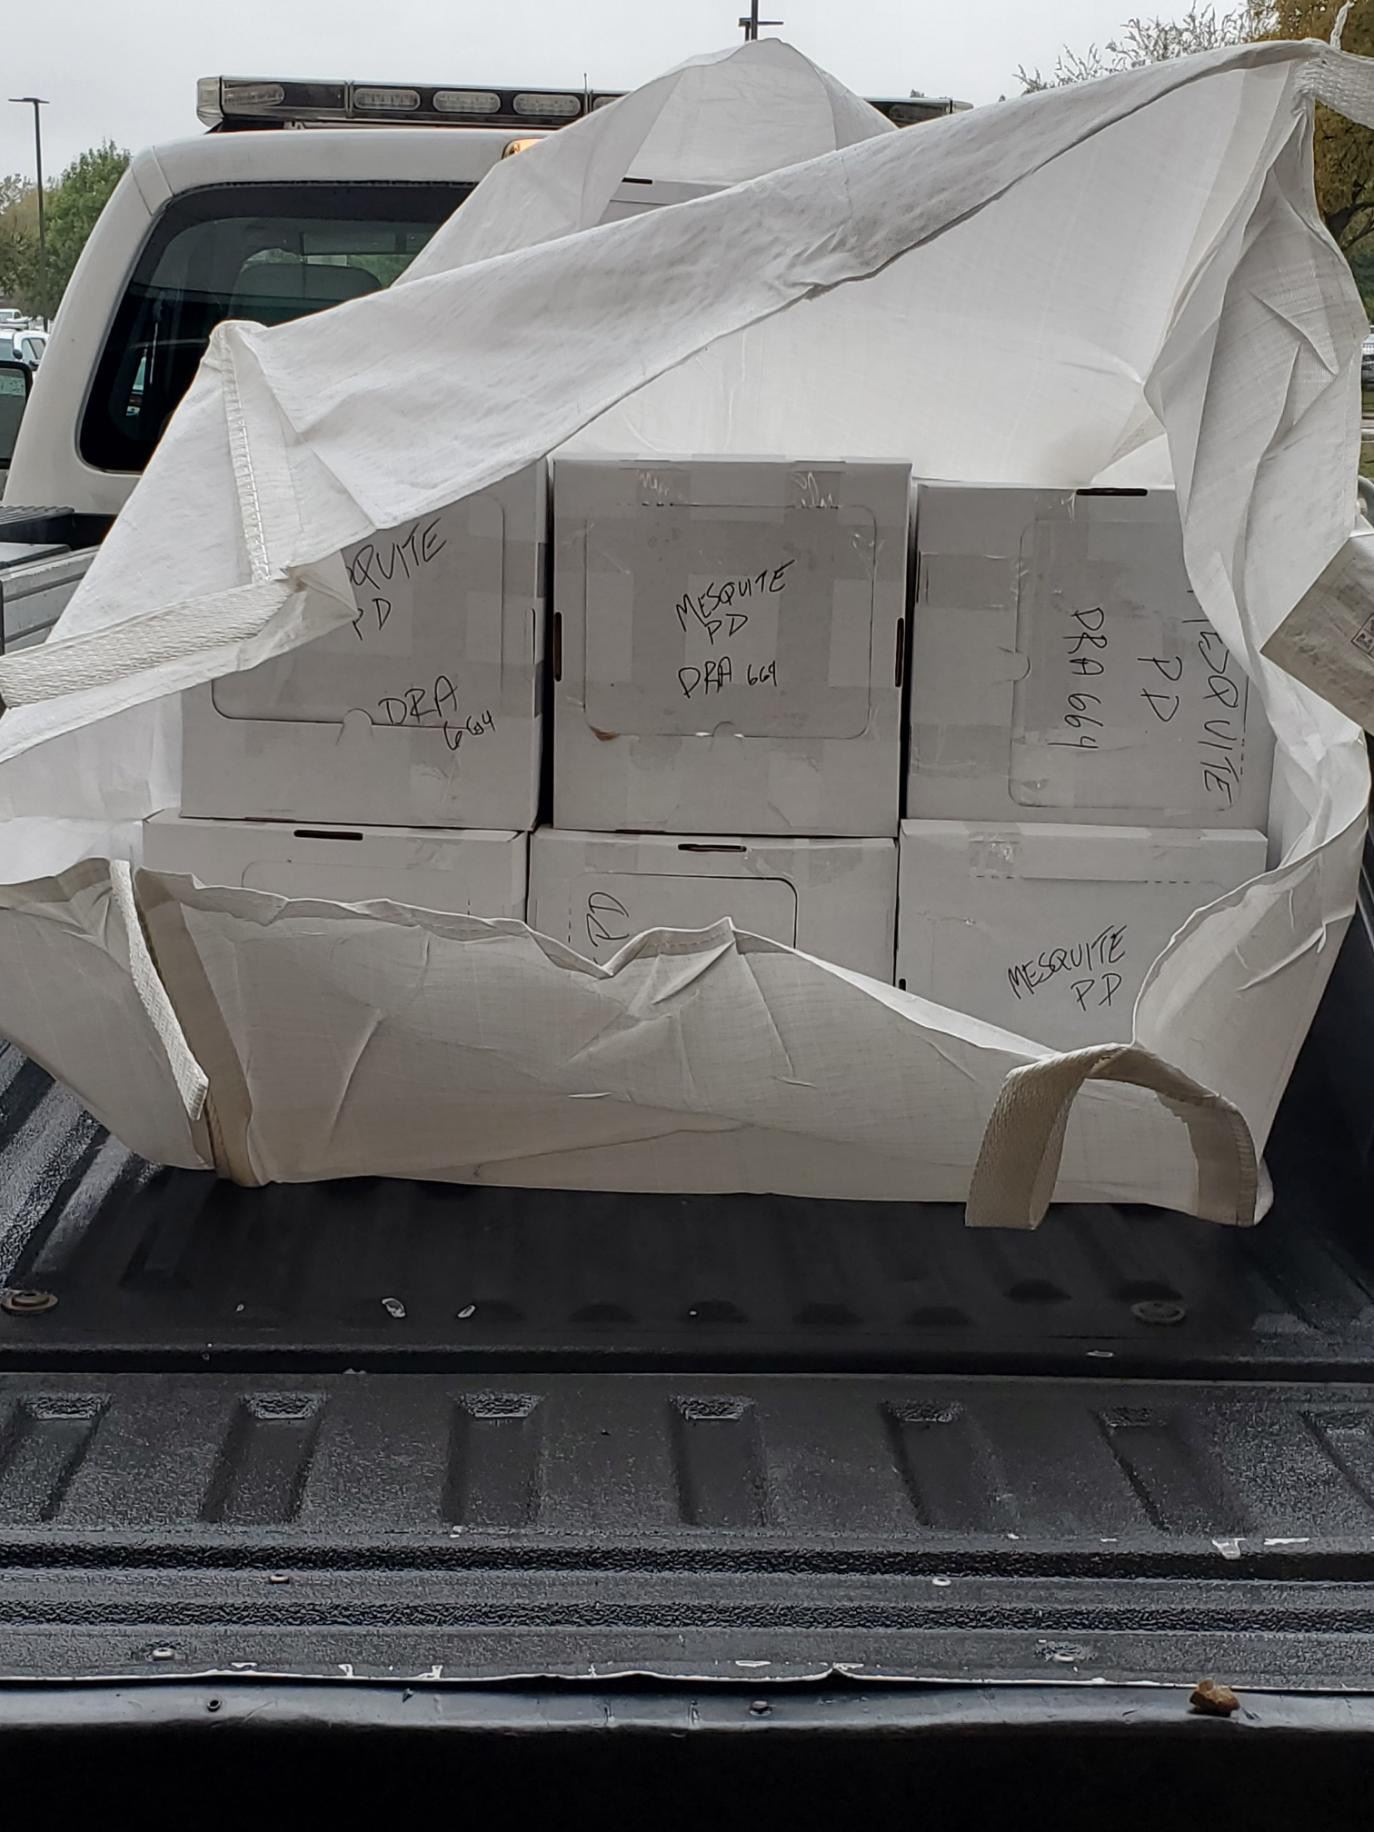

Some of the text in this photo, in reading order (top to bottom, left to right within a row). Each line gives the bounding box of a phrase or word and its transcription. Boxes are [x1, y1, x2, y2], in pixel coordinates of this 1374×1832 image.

[346, 518, 447, 590] QUITE
[676, 559, 796, 632] MESQUITE
[704, 613, 748, 645] PD
[378, 675, 496, 751] DRA 664
[678, 656, 733, 699] DRA
[1047, 607, 1108, 749] DRA 664
[1007, 924, 1128, 1000] MESQUITE
[1070, 972, 1122, 1012] PD
